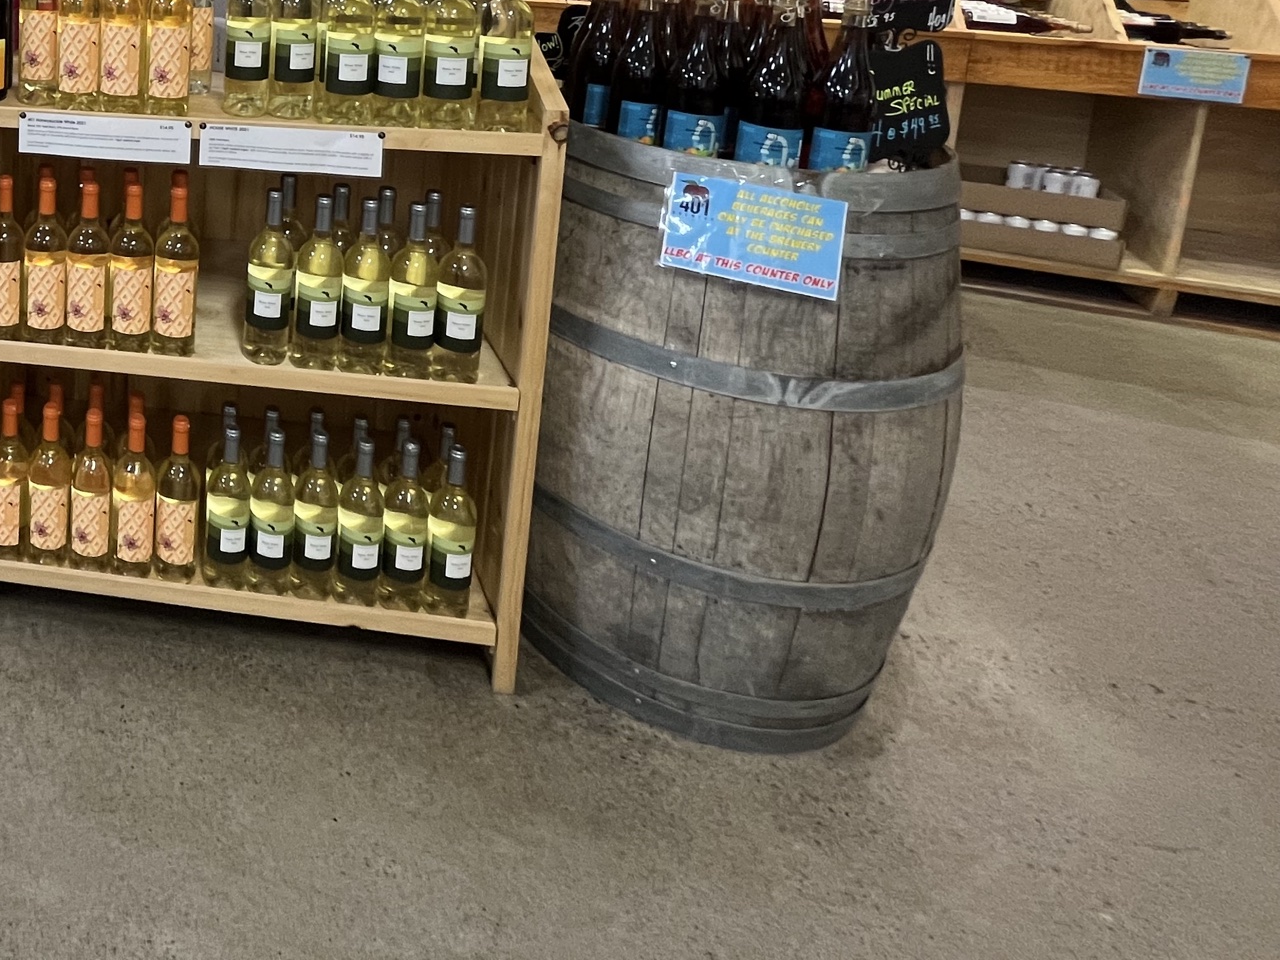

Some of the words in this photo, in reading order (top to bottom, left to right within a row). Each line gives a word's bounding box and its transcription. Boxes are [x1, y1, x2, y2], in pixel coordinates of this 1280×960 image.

[678, 196, 710, 217] 401
[736, 189, 756, 201] ALL
[759, 194, 823, 213] ALCOHOLIC
[731, 201, 798, 222] BEVERAGES
[801, 215, 824, 226] CAN
[717, 212, 747, 225] ONLY
[750, 218, 765, 228] BE
[769, 221, 835, 242] PURCHASED
[745, 229, 765, 241] THE
[769, 234, 822, 253] BREWERY
[746, 243, 800, 262] COUNTER
[715, 257, 741, 271] THIS
[745, 263, 800, 283] COUNTER
[802, 276, 836, 290] ONLY
